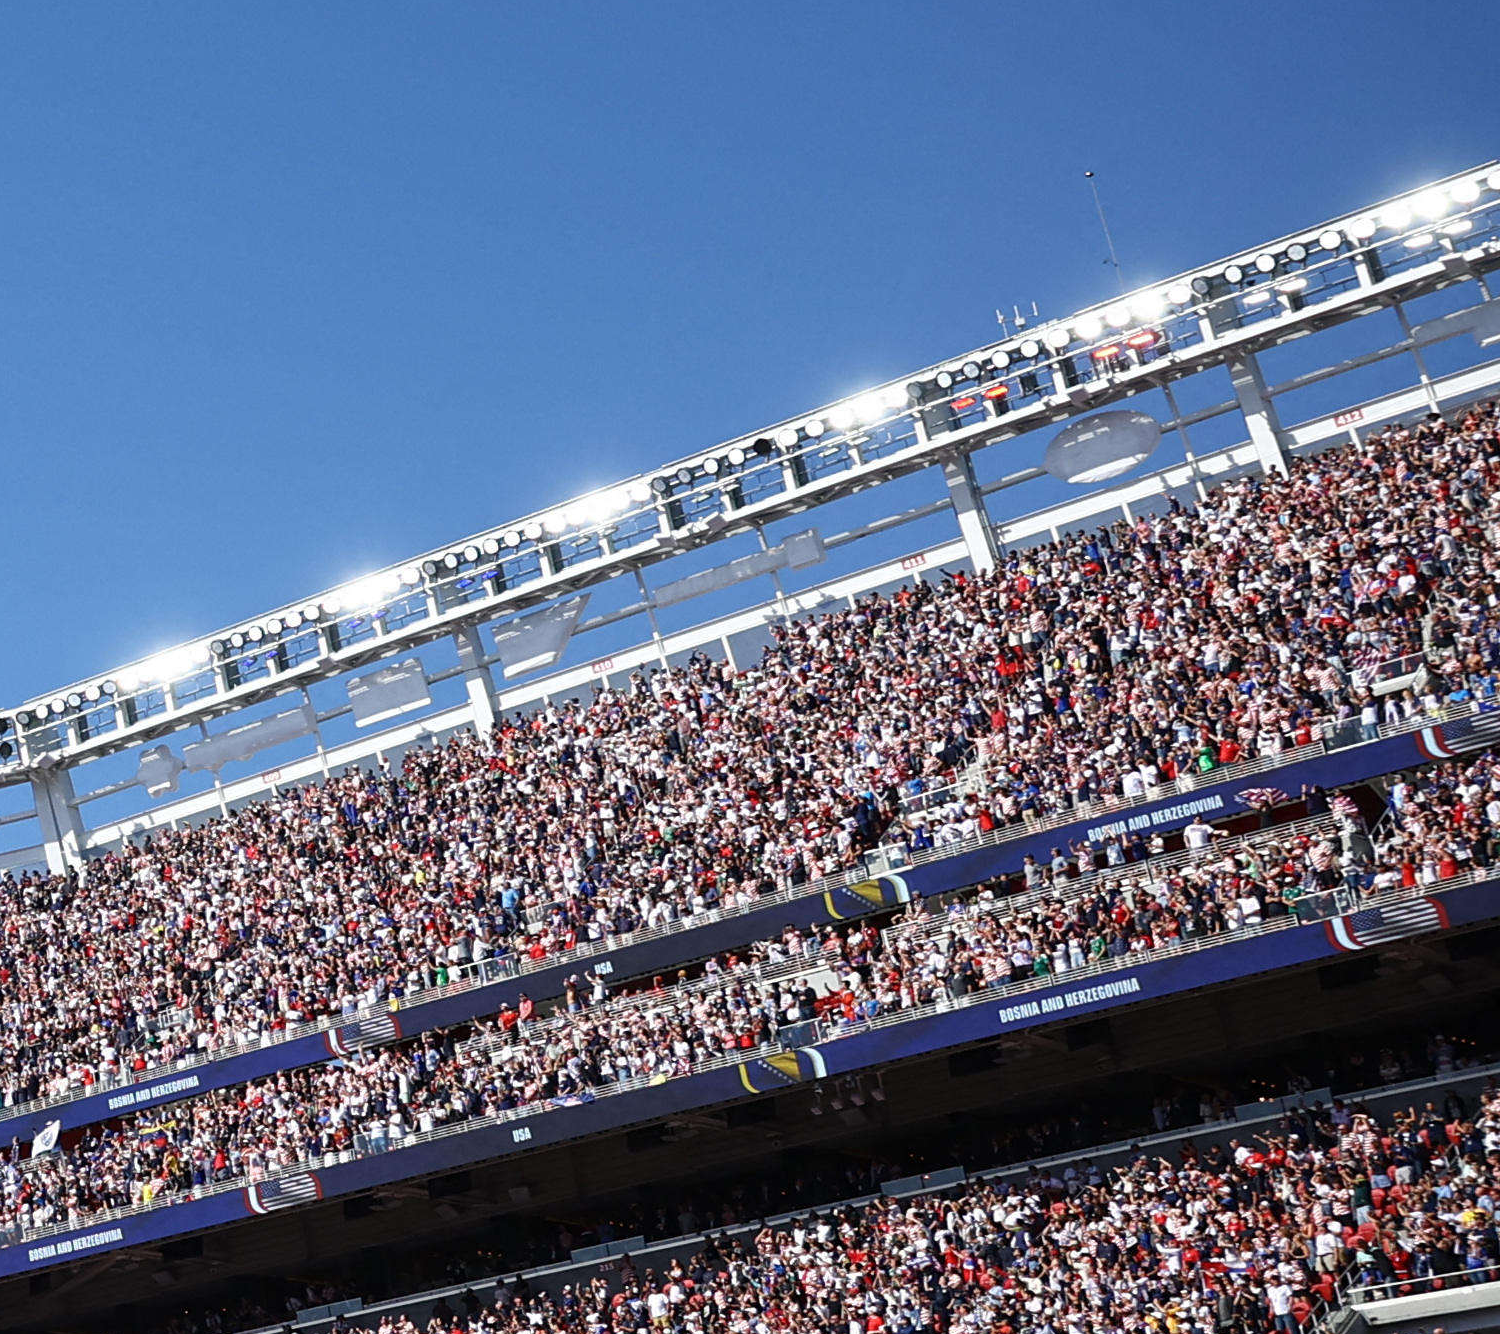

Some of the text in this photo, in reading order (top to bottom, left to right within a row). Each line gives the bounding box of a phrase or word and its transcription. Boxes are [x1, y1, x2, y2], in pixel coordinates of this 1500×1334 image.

[1129, 815, 1150, 831] AND
[1151, 795, 1223, 825] HERZEGOVINA
[595, 961, 613, 974] USA
[999, 978, 1140, 1023] BOSNIA AND HERZEGOVINA
[513, 1127, 531, 1142] USA
[29, 1228, 122, 1261] BOSNIA AND HERZEGOVINA
[599, 1262, 615, 1272] 215
